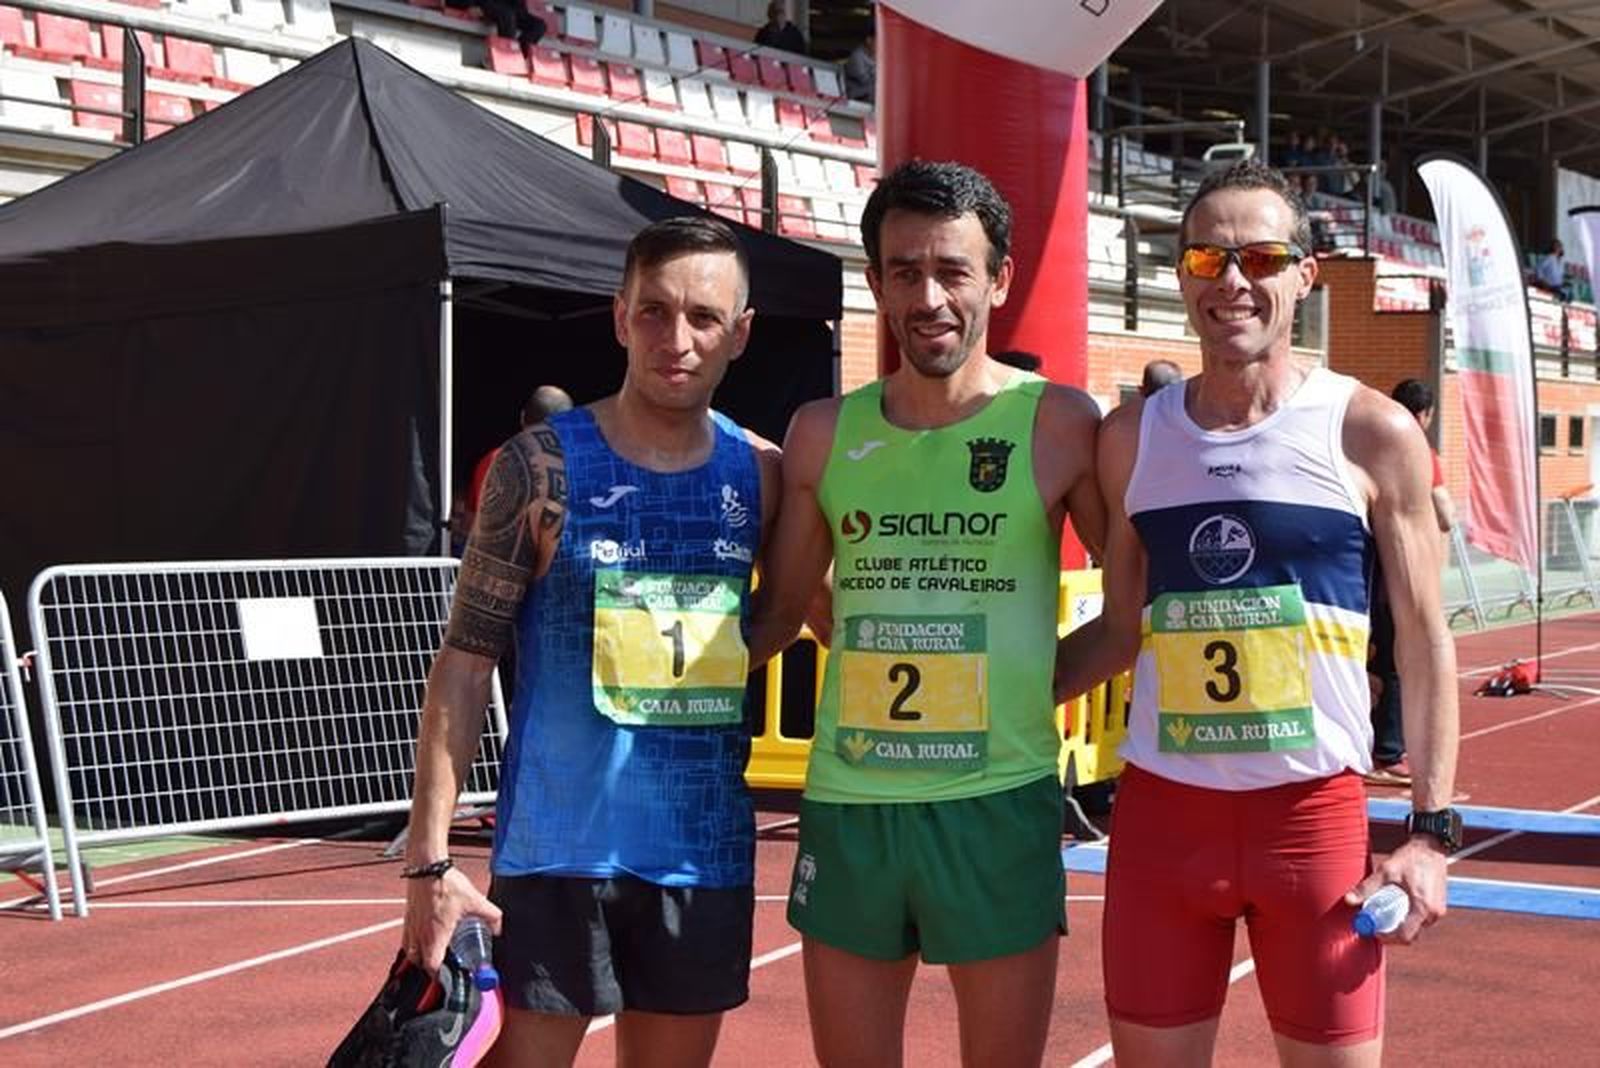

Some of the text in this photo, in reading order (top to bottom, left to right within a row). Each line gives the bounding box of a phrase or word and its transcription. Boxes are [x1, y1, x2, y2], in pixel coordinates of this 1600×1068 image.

[855, 555, 987, 572] CLUBE ATLÉTICO
[890, 577, 911, 590] DE
[918, 577, 1016, 592] CAVALEIROS
[1190, 611, 1282, 628] CAJA RURAL
[661, 620, 685, 678] 1
[876, 637, 965, 651] CAJA RURAL
[1203, 640, 1241, 703] 3
[888, 662, 922, 720] 2
[639, 697, 734, 714] CAJA RURAL
[1194, 721, 1306, 742] CAJA RURAL
[875, 742, 980, 760] CAJA RURAL
